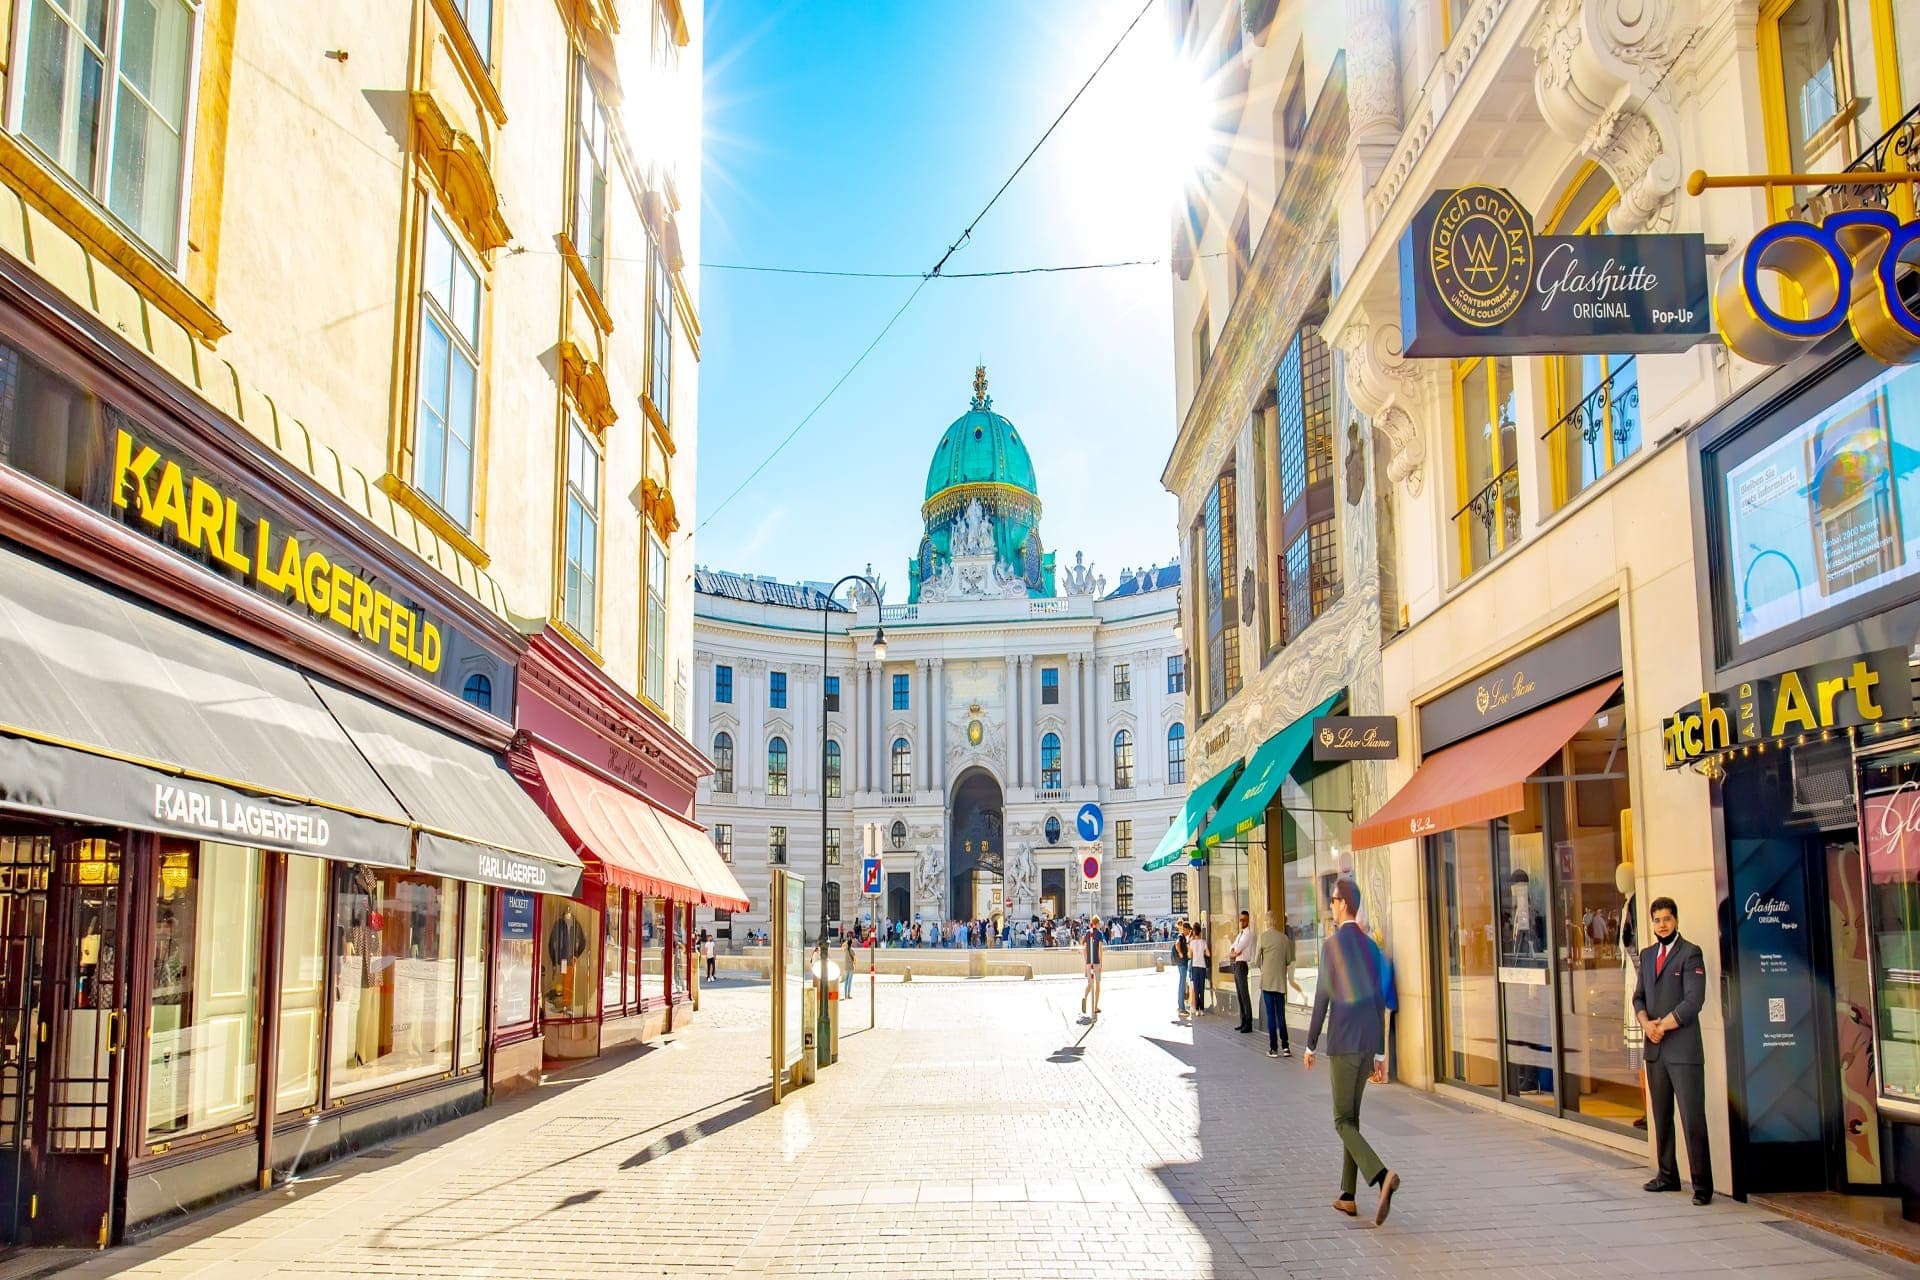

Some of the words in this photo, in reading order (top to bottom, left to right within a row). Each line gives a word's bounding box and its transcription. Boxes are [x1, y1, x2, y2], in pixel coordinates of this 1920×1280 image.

[1434, 196, 1471, 271] Watch
[1475, 194, 1514, 226] and
[1507, 228, 1526, 267] Art
[1536, 243, 1659, 312] Glashütte
[1451, 294, 1476, 317] UNIQUE
[1476, 289, 1520, 319] COLLECTIONS
[1458, 284, 1511, 308] CONTEMPORARY
[1573, 303, 1631, 319] ORIGINAL
[112, 428, 250, 574] KARL
[256, 517, 442, 673] LAGERFELD
[1739, 683, 1756, 739] AND
[1771, 661, 1883, 737] Art
[1334, 727, 1361, 748] Loro
[1362, 726, 1392, 748] Piana
[154, 783, 219, 829] KARL
[220, 799, 330, 847] LAGERFELD
[478, 854, 502, 879] KARL
[502, 860, 546, 886] LAGERFELD
[1084, 880, 1099, 890] Zone
[509, 896, 529, 909] HACKETT
[1744, 891, 1790, 920] Glashütte
